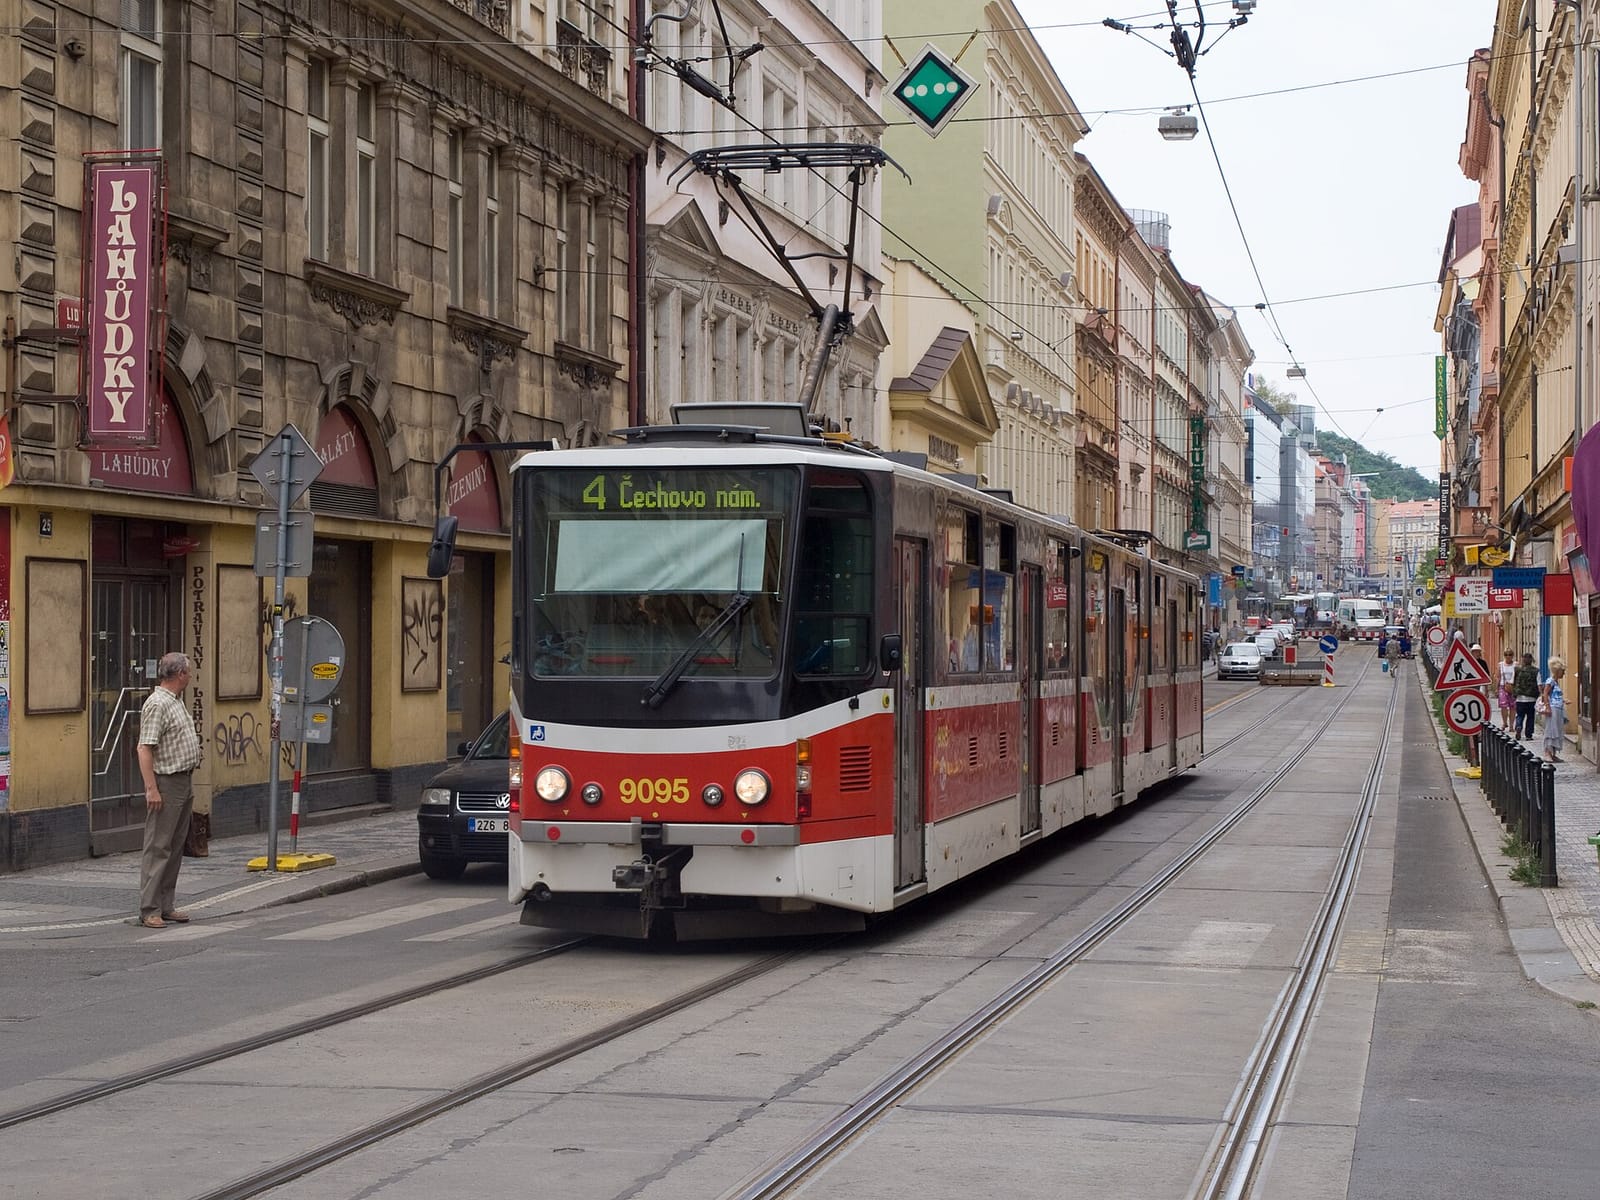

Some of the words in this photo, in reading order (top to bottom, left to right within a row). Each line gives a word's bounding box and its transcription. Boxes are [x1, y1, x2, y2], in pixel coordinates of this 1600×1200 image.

[103, 180, 137, 423] LAHŮDKY
[316, 425, 357, 464] ALÁTY
[582, 474, 606, 510] 4
[619, 474, 706, 509] Čechovo
[716, 483, 761, 508] nám.
[1441, 489, 1449, 513] Barrio
[1441, 524, 1449, 535] de
[192, 566, 205, 670] POTRAVINY
[1453, 700, 1482, 724] 30
[619, 778, 690, 804] 9095
[477, 820, 495, 831] 2Z6
